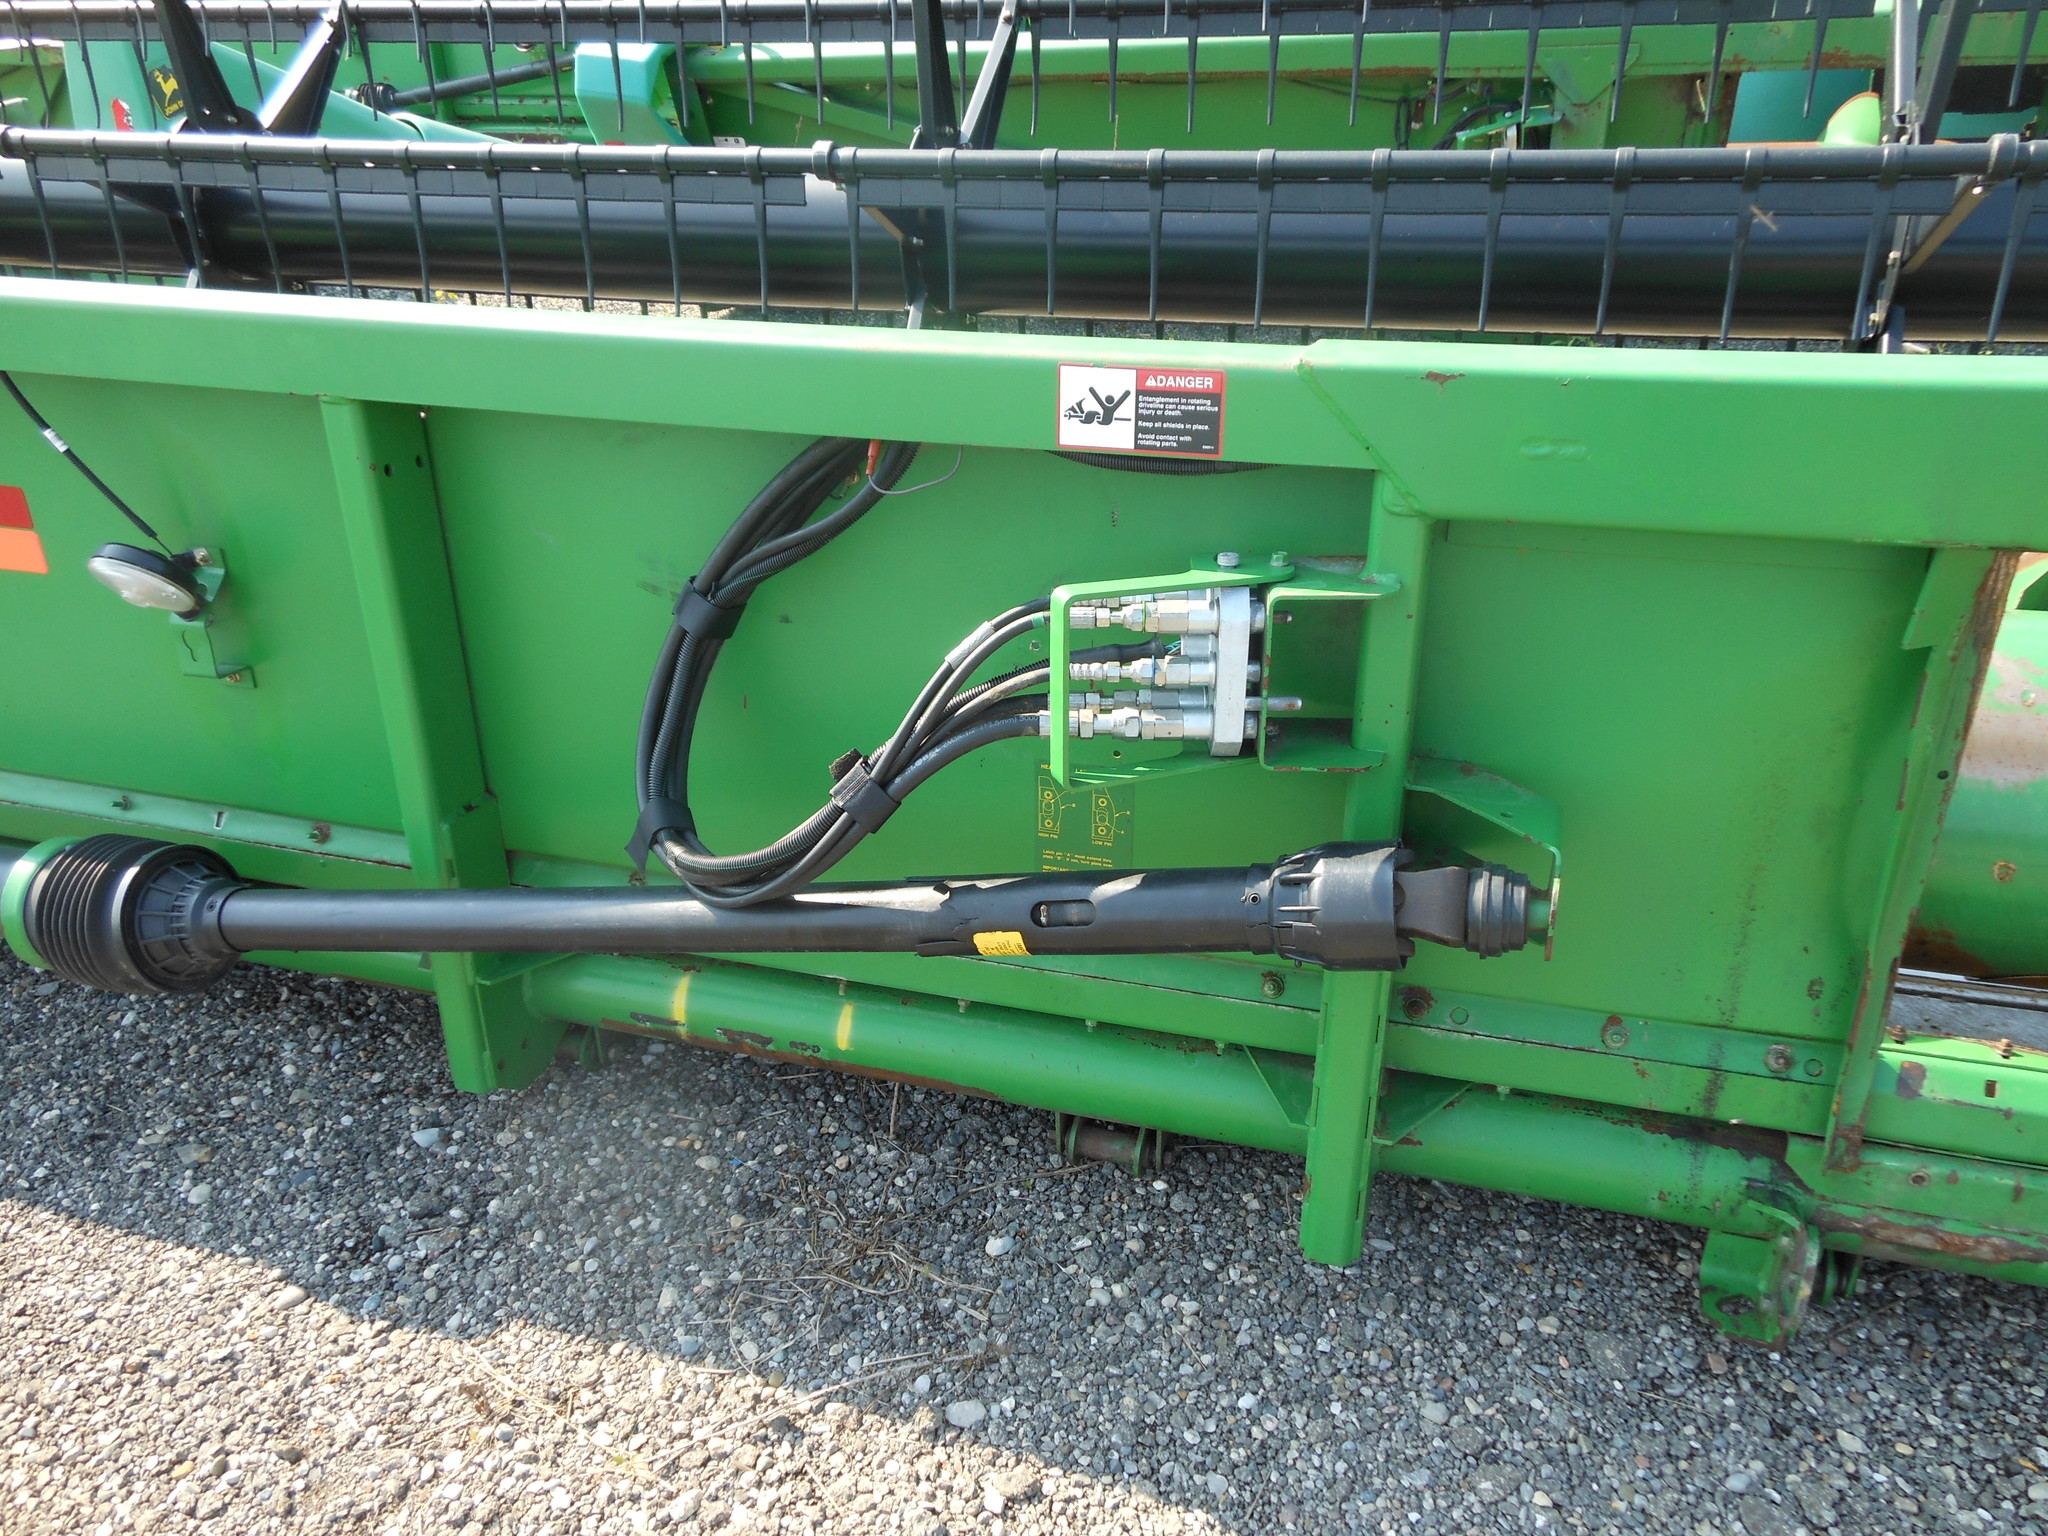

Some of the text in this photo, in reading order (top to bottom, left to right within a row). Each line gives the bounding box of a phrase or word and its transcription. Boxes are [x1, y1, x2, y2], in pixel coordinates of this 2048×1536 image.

[1156, 375, 1214, 389] DANGER
[1138, 395, 1180, 404] Entanglement
[1138, 420, 1154, 428] Keep
